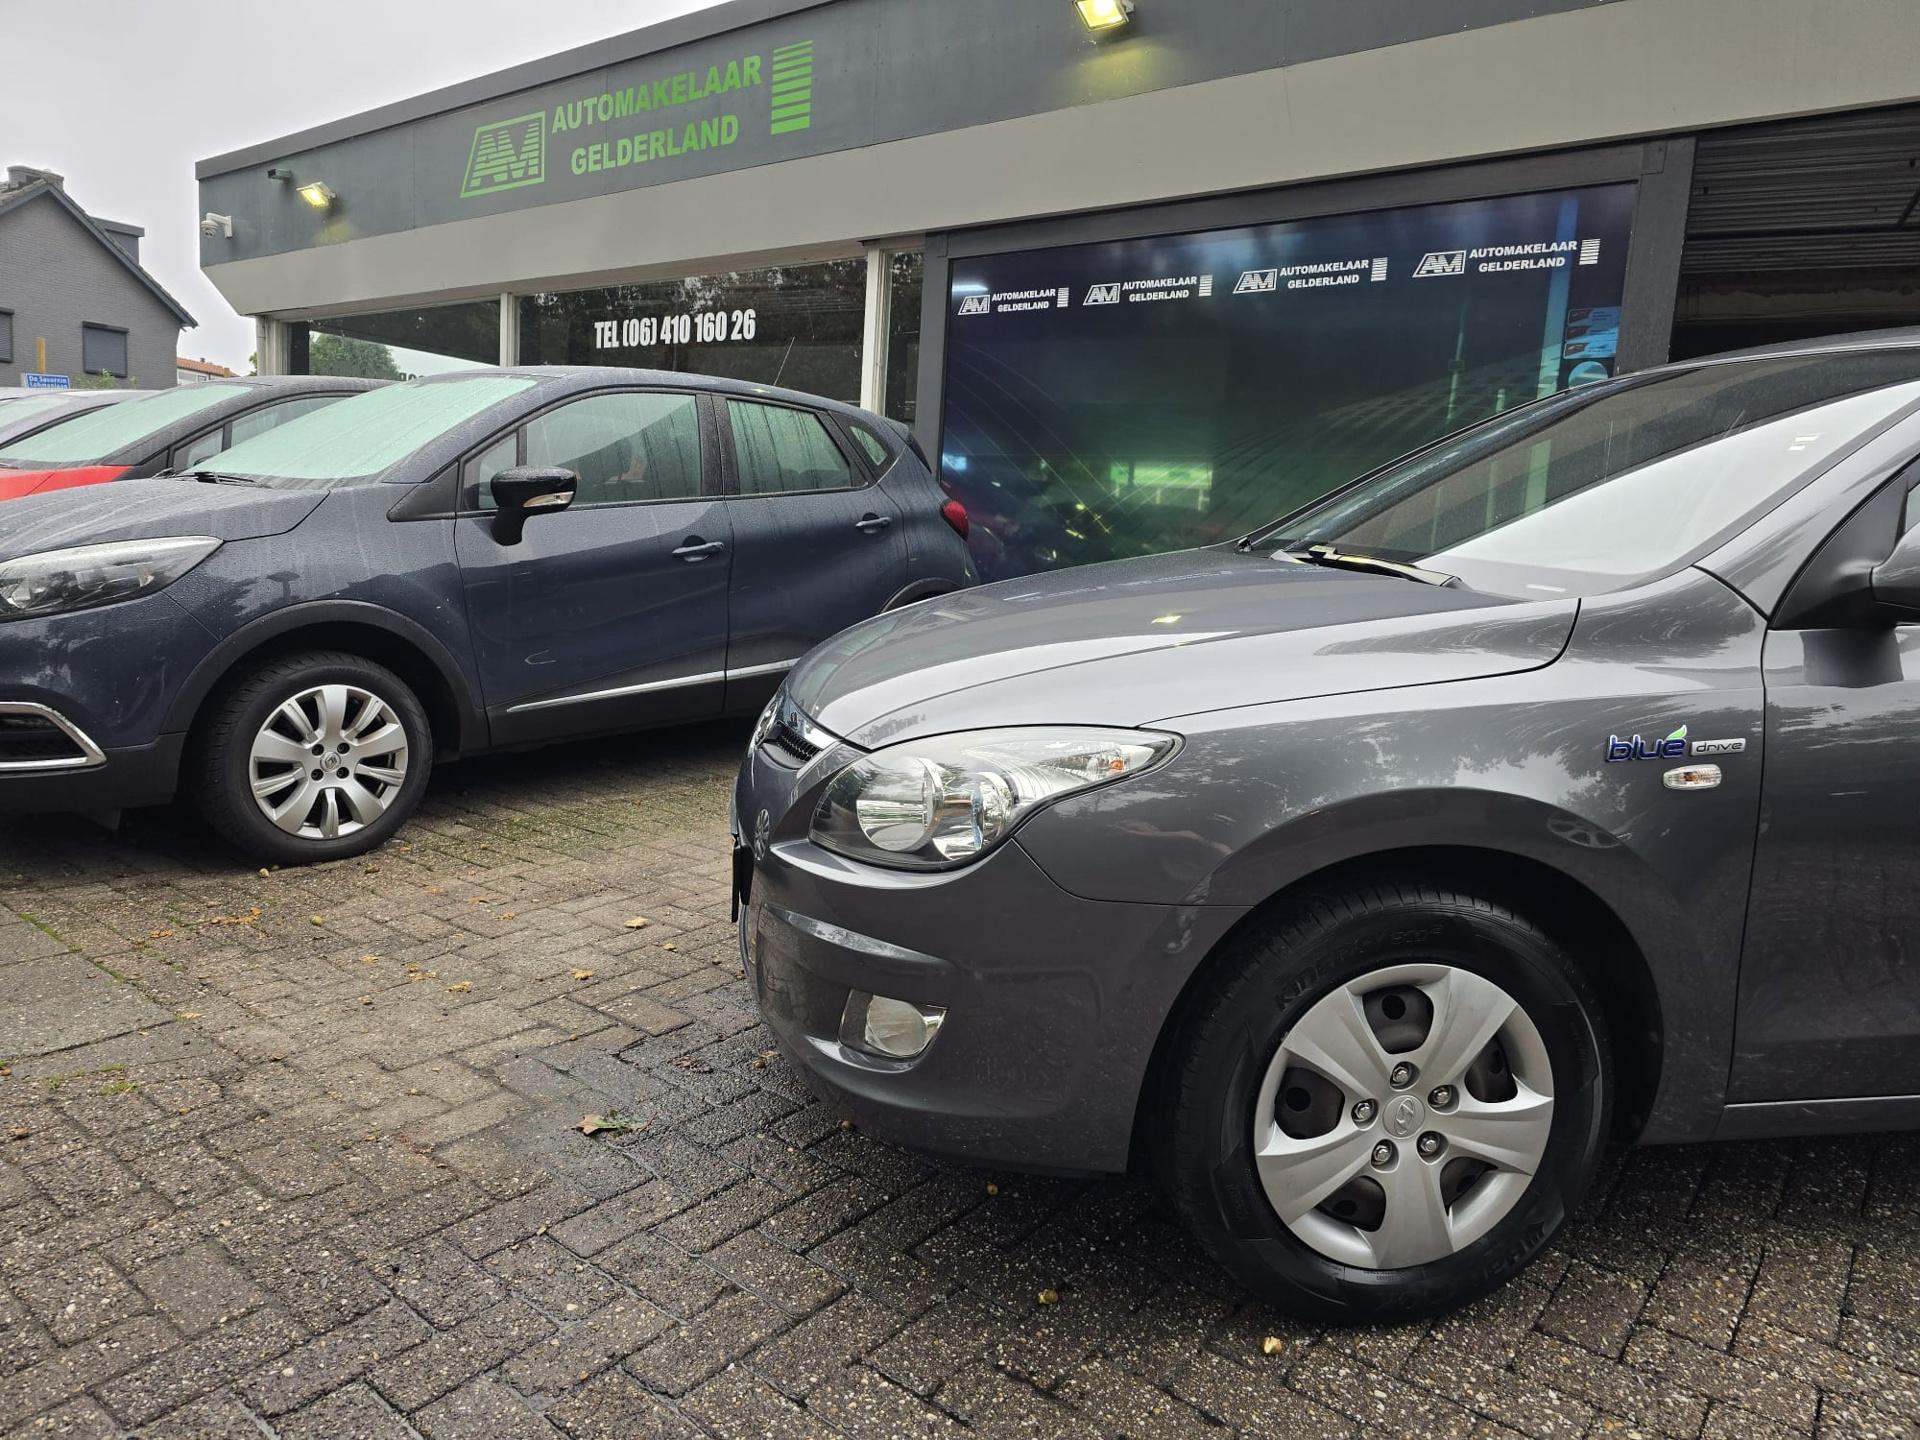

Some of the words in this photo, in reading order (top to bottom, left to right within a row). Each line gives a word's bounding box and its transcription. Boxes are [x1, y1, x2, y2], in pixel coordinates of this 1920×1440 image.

[551, 54, 762, 134] AUTOMAKELAAR
[570, 114, 739, 176] GELDERLAND
[1469, 240, 1578, 259] AUTOMAKELAAR
[1279, 259, 1370, 277] AUTOMAKELAAR
[1478, 257, 1566, 273] GELDERLAND
[1122, 276, 1198, 291] AUTOMAKELAAR
[1287, 274, 1360, 290] GELDERLAND
[991, 288, 1057, 302] AUTOMAKELAAR
[1129, 289, 1190, 303] GELDERLAND
[997, 301, 1050, 313] GELDERLAND
[594, 320, 619, 349] TEL
[622, 317, 657, 347] (06)
[660, 314, 691, 345] 410
[694, 311, 727, 343] 160
[730, 308, 756, 341] 26
[1606, 733, 1688, 762] blue
[1695, 741, 1743, 754] drive
